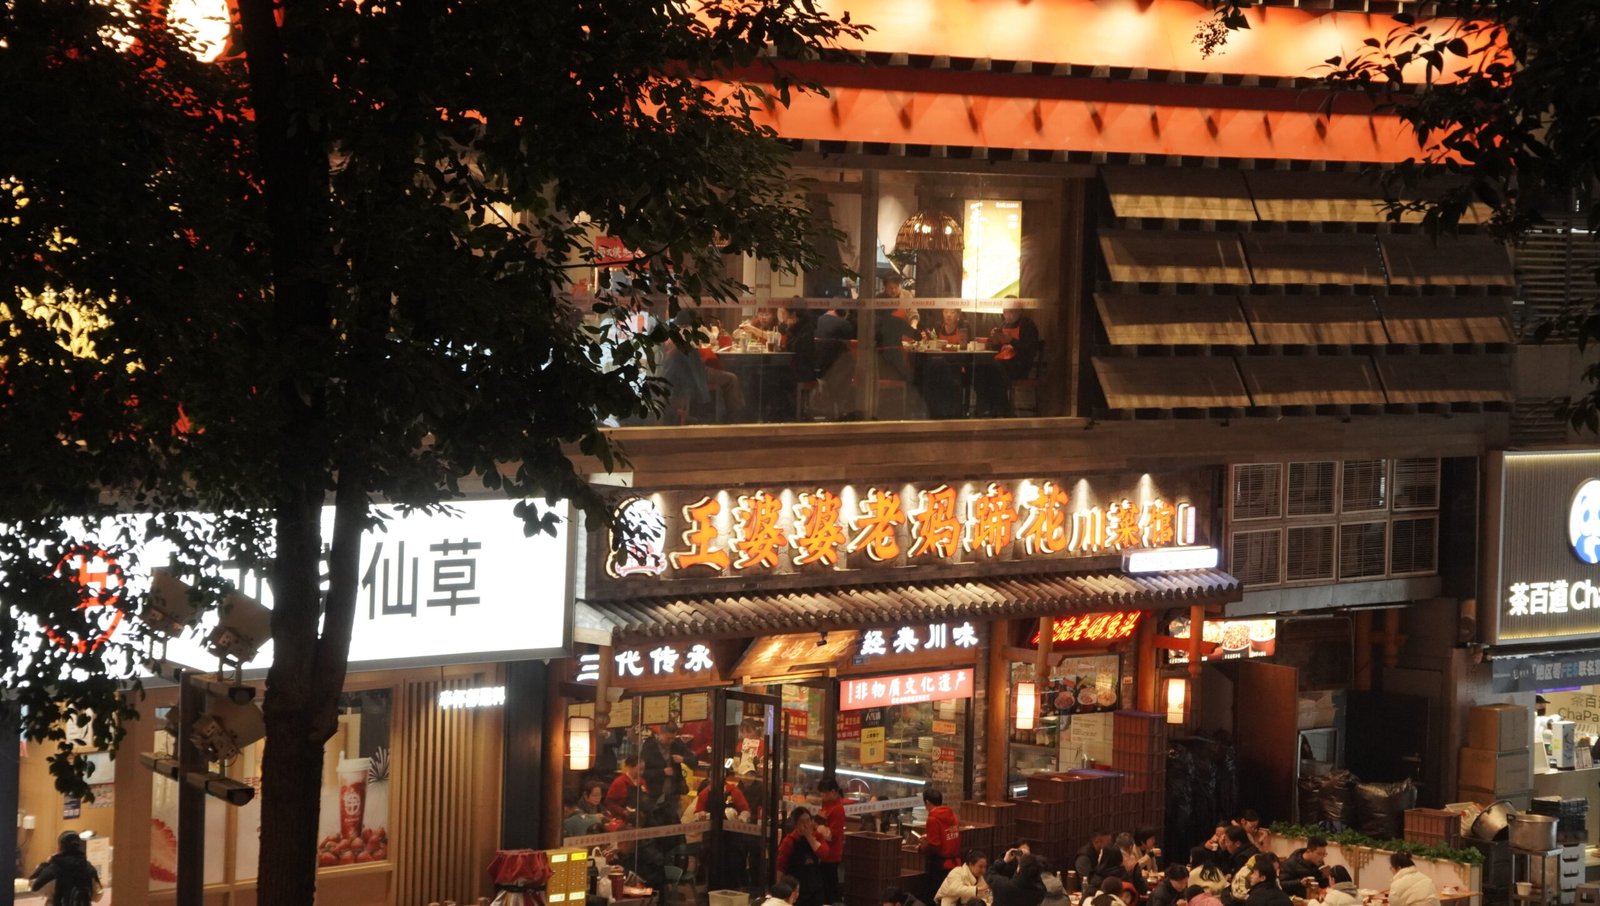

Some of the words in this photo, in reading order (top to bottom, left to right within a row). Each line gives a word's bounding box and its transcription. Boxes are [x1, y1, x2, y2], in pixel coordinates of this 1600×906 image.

[670, 481, 1175, 569] 王婆婆老妈蹄花川菜馆
[362, 538, 482, 620] 仙草
[1509, 579, 1569, 616] 茶百道
[1569, 578, 1600, 611] Ch
[860, 620, 979, 656] 经典川味
[576, 644, 714, 682] 三代传承
[855, 670, 967, 699] 非物质文化遗产
[1570, 691, 1600, 709] 茶百
[1558, 707, 1600, 723] ChaPa
